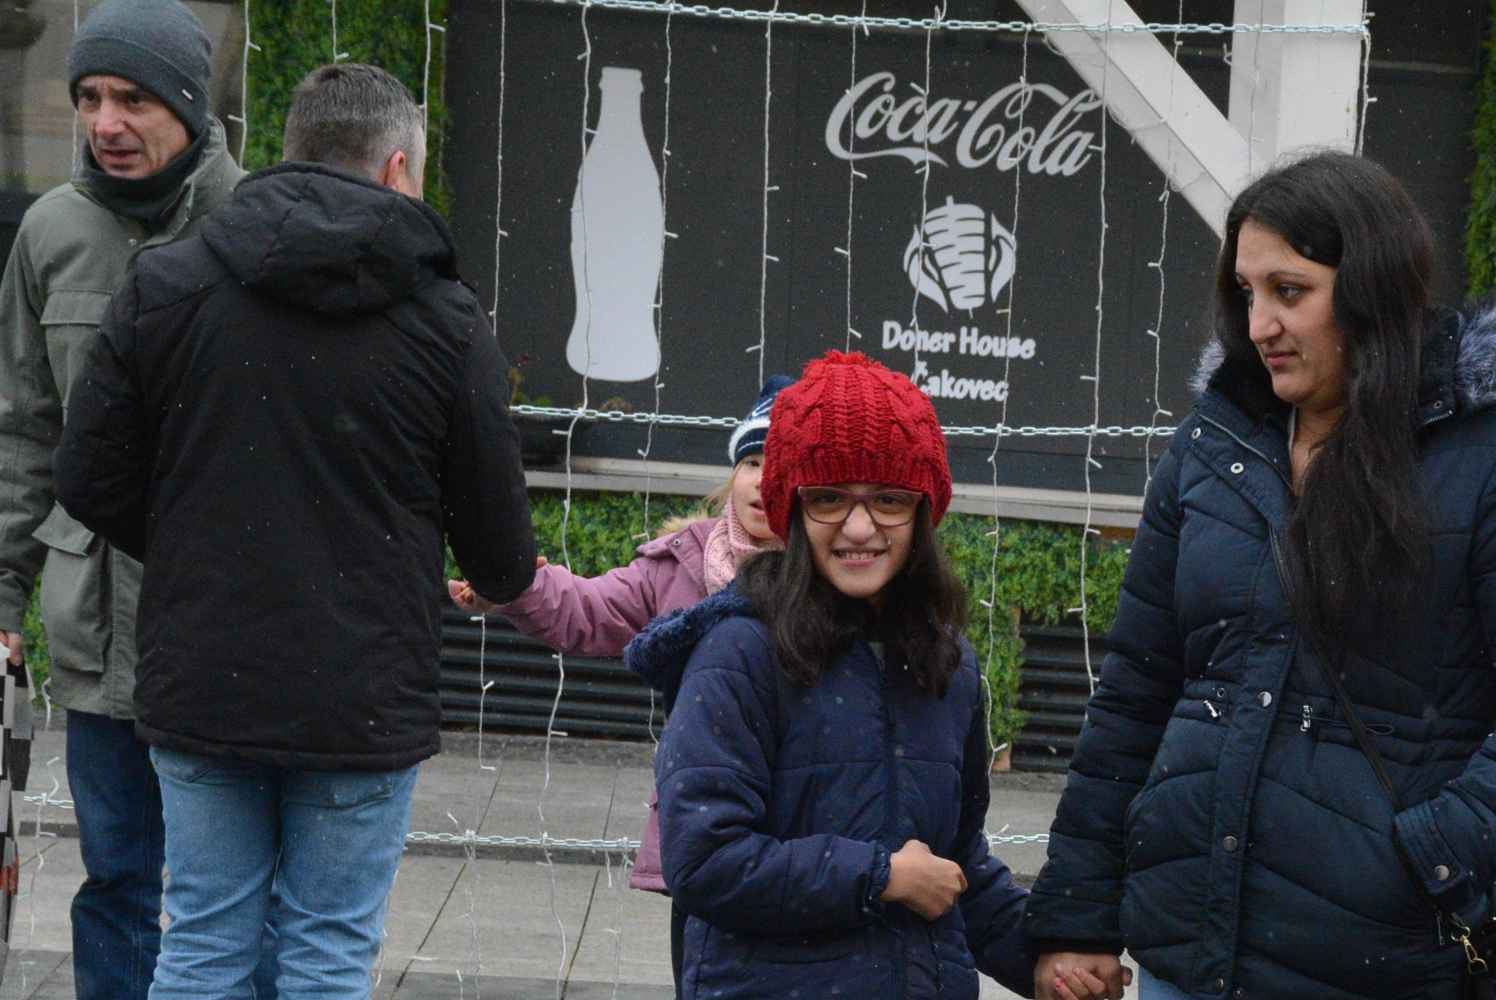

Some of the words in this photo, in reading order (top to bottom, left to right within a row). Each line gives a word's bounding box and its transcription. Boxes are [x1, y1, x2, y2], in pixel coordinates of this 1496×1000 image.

[825, 71, 1103, 177] Coca-Cola
[881, 320, 956, 354] Doner
[958, 326, 1037, 360] House
